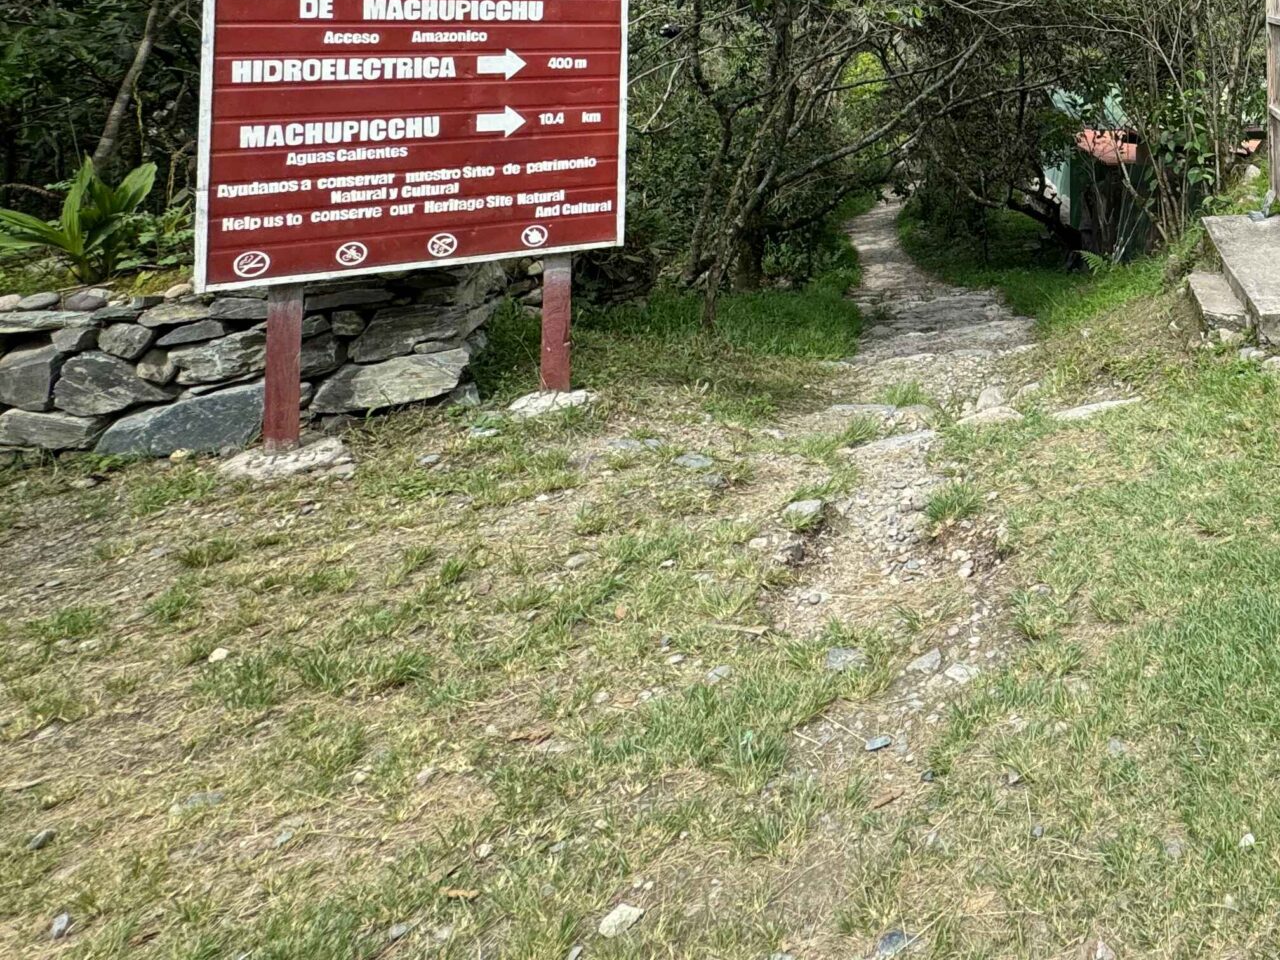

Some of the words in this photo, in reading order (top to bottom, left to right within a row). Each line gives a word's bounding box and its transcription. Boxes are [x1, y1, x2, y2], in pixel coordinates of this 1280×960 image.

[324, 31, 380, 44] Acceso
[412, 30, 488, 43] Amazonico
[231, 57, 456, 83] HIDROELECTRICA
[547, 57, 573, 69] 400
[574, 58, 588, 69] m
[239, 116, 440, 148] MACHUPICCHU
[581, 111, 601, 123] km
[286, 151, 335, 166] Aguas
[336, 147, 408, 162] Calientes
[217, 180, 299, 198] Ayudanos
[300, 179, 311, 190] a
[317, 173, 395, 189] conservar
[405, 167, 461, 183] nuestro
[462, 165, 495, 178] Sitio
[502, 163, 520, 175] de
[526, 157, 597, 174] patrimonio
[330, 187, 387, 204] Natural
[389, 188, 398, 200] y
[401, 183, 459, 199] Cultural
[222, 217, 261, 231] Help
[263, 215, 284, 227] us
[286, 213, 302, 225] to
[310, 206, 382, 223] conserve
[390, 204, 415, 216] our
[424, 198, 484, 213] Heritage
[486, 195, 513, 208] Site
[517, 190, 565, 205] Natural
[535, 204, 560, 218] And
[562, 200, 612, 215] Cultural
